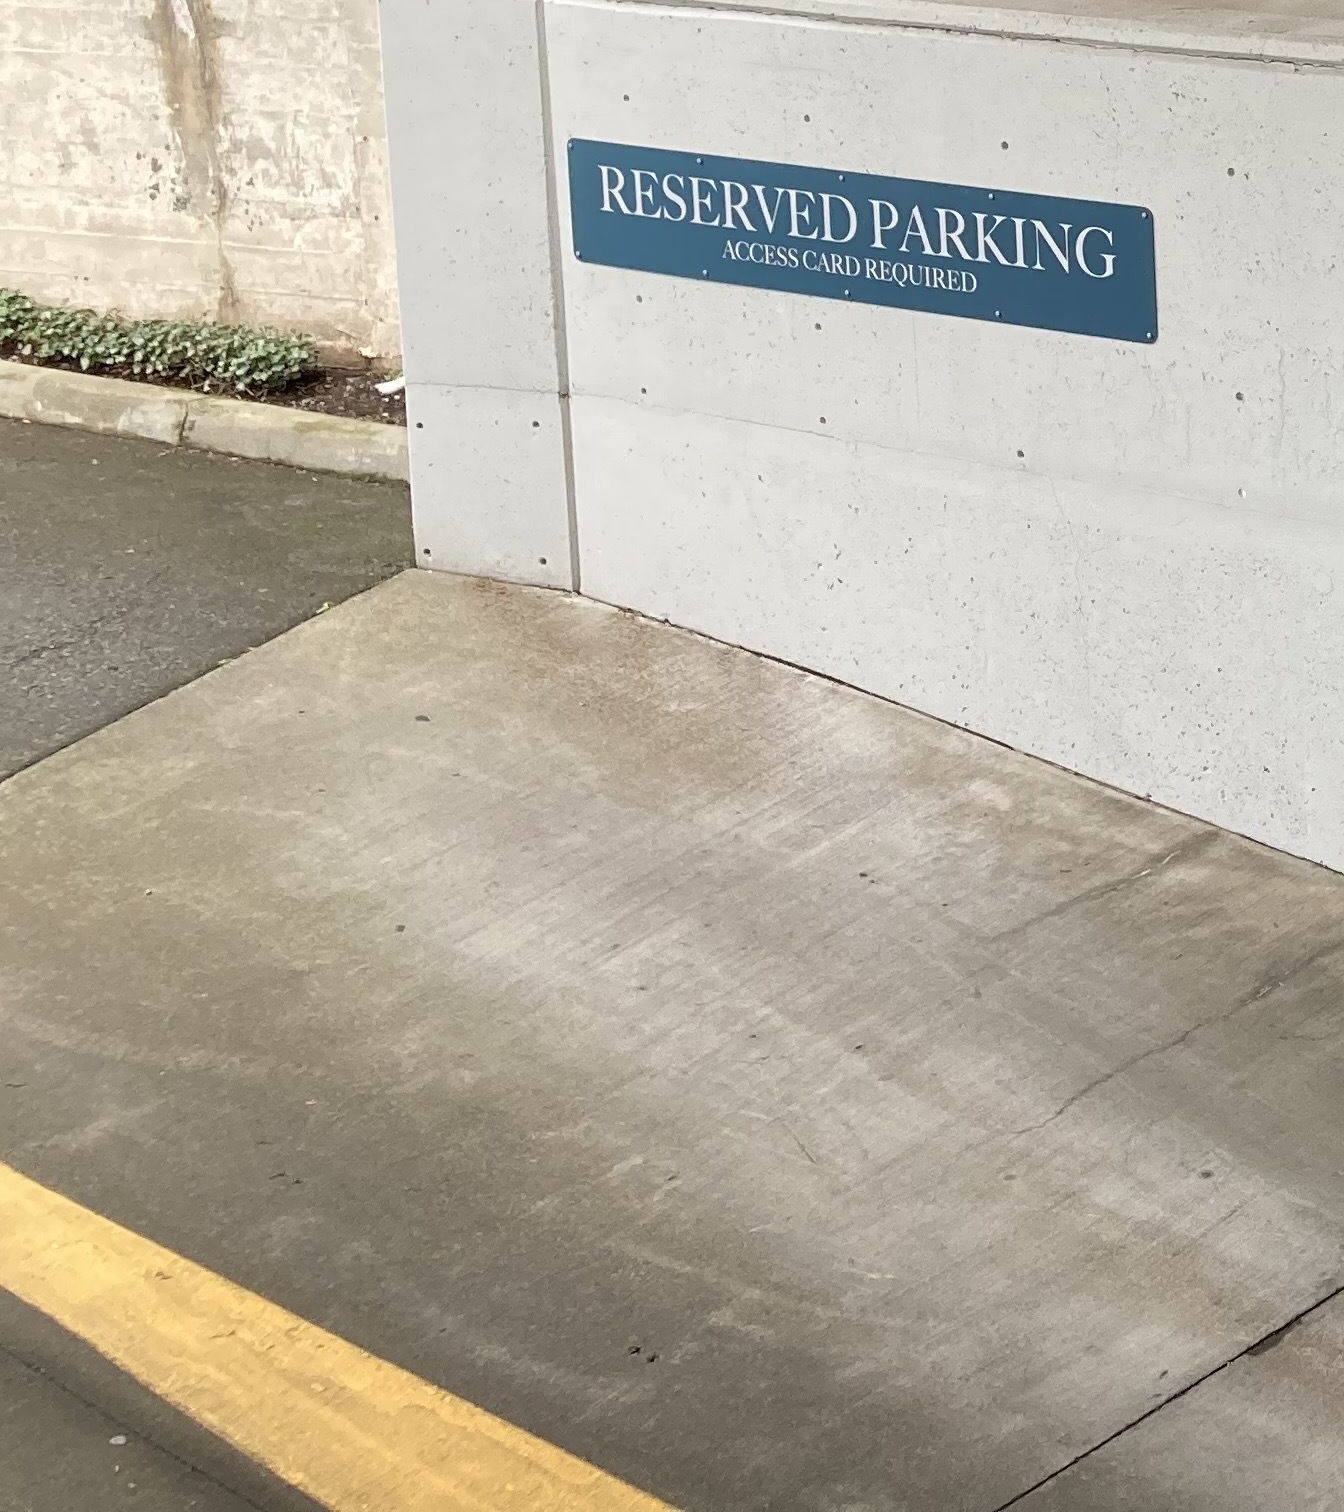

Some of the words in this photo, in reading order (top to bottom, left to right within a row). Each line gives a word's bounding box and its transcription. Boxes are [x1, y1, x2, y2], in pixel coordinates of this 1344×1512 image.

[597, 164, 858, 243] RESERVED
[868, 199, 1117, 278] PARKING
[722, 239, 800, 268] ACCESS
[802, 250, 861, 277] CARD
[864, 259, 978, 294] REQUIRED
